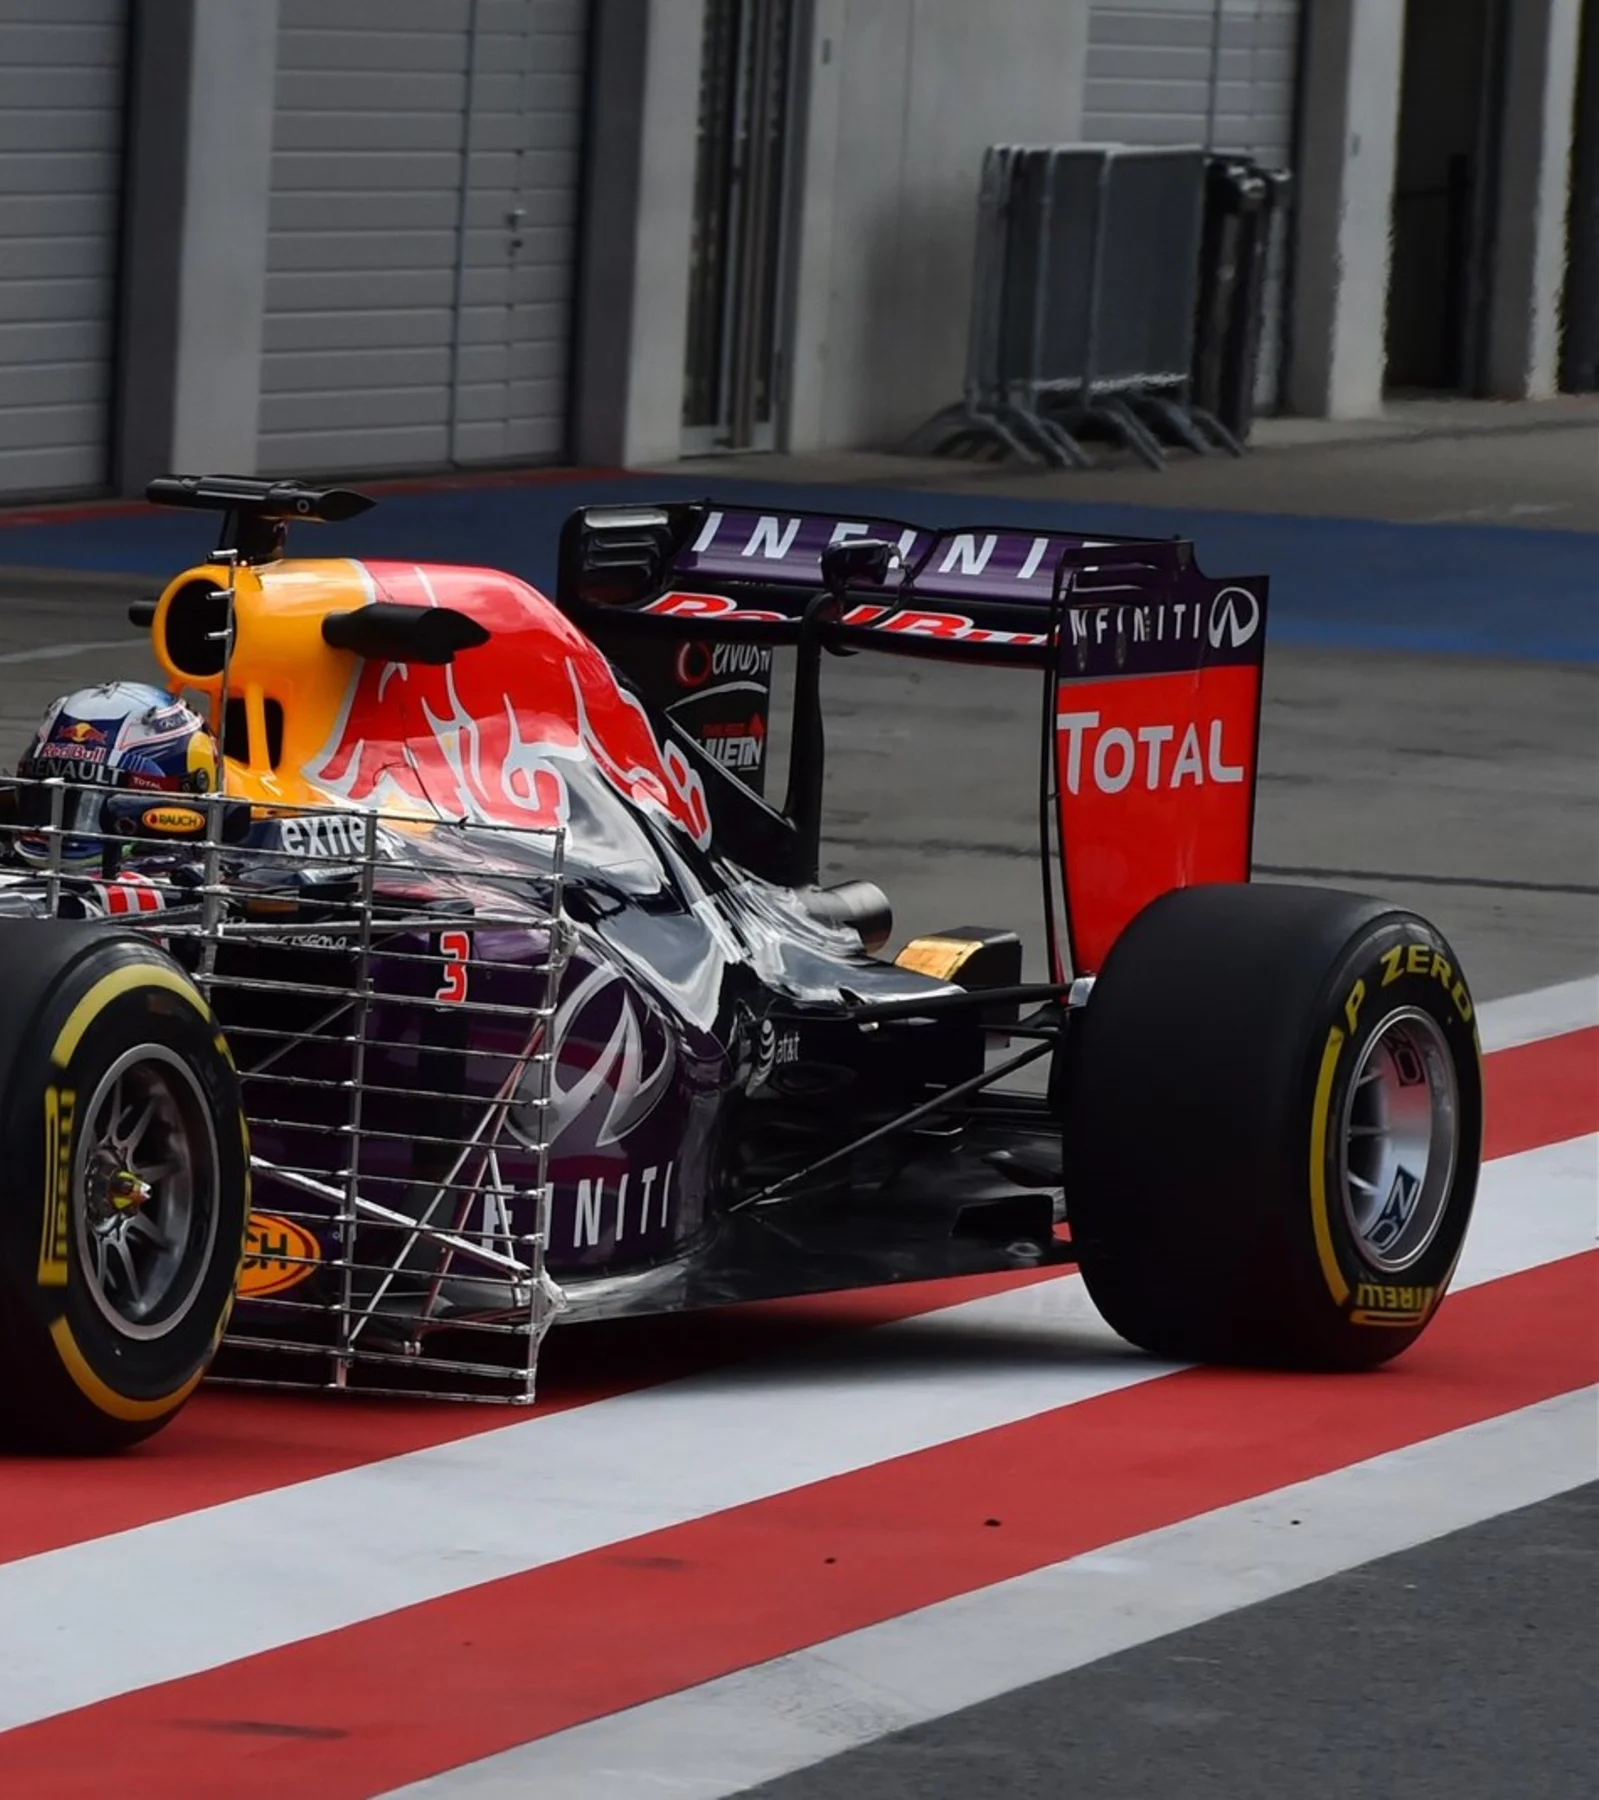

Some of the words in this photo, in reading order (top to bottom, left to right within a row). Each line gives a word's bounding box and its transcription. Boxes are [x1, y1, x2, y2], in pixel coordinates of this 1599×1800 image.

[43, 742, 71, 758] Red
[70, 745, 106, 764] Bull
[1056, 711, 1244, 796] TOTAL
[28, 758, 125, 786] RENAULT
[133, 777, 162, 790] TOTAL
[159, 814, 197, 827] RAUCH
[435, 931, 469, 1004] 3
[1344, 979, 1366, 1035] P
[1380, 944, 1473, 1022] ZERO
